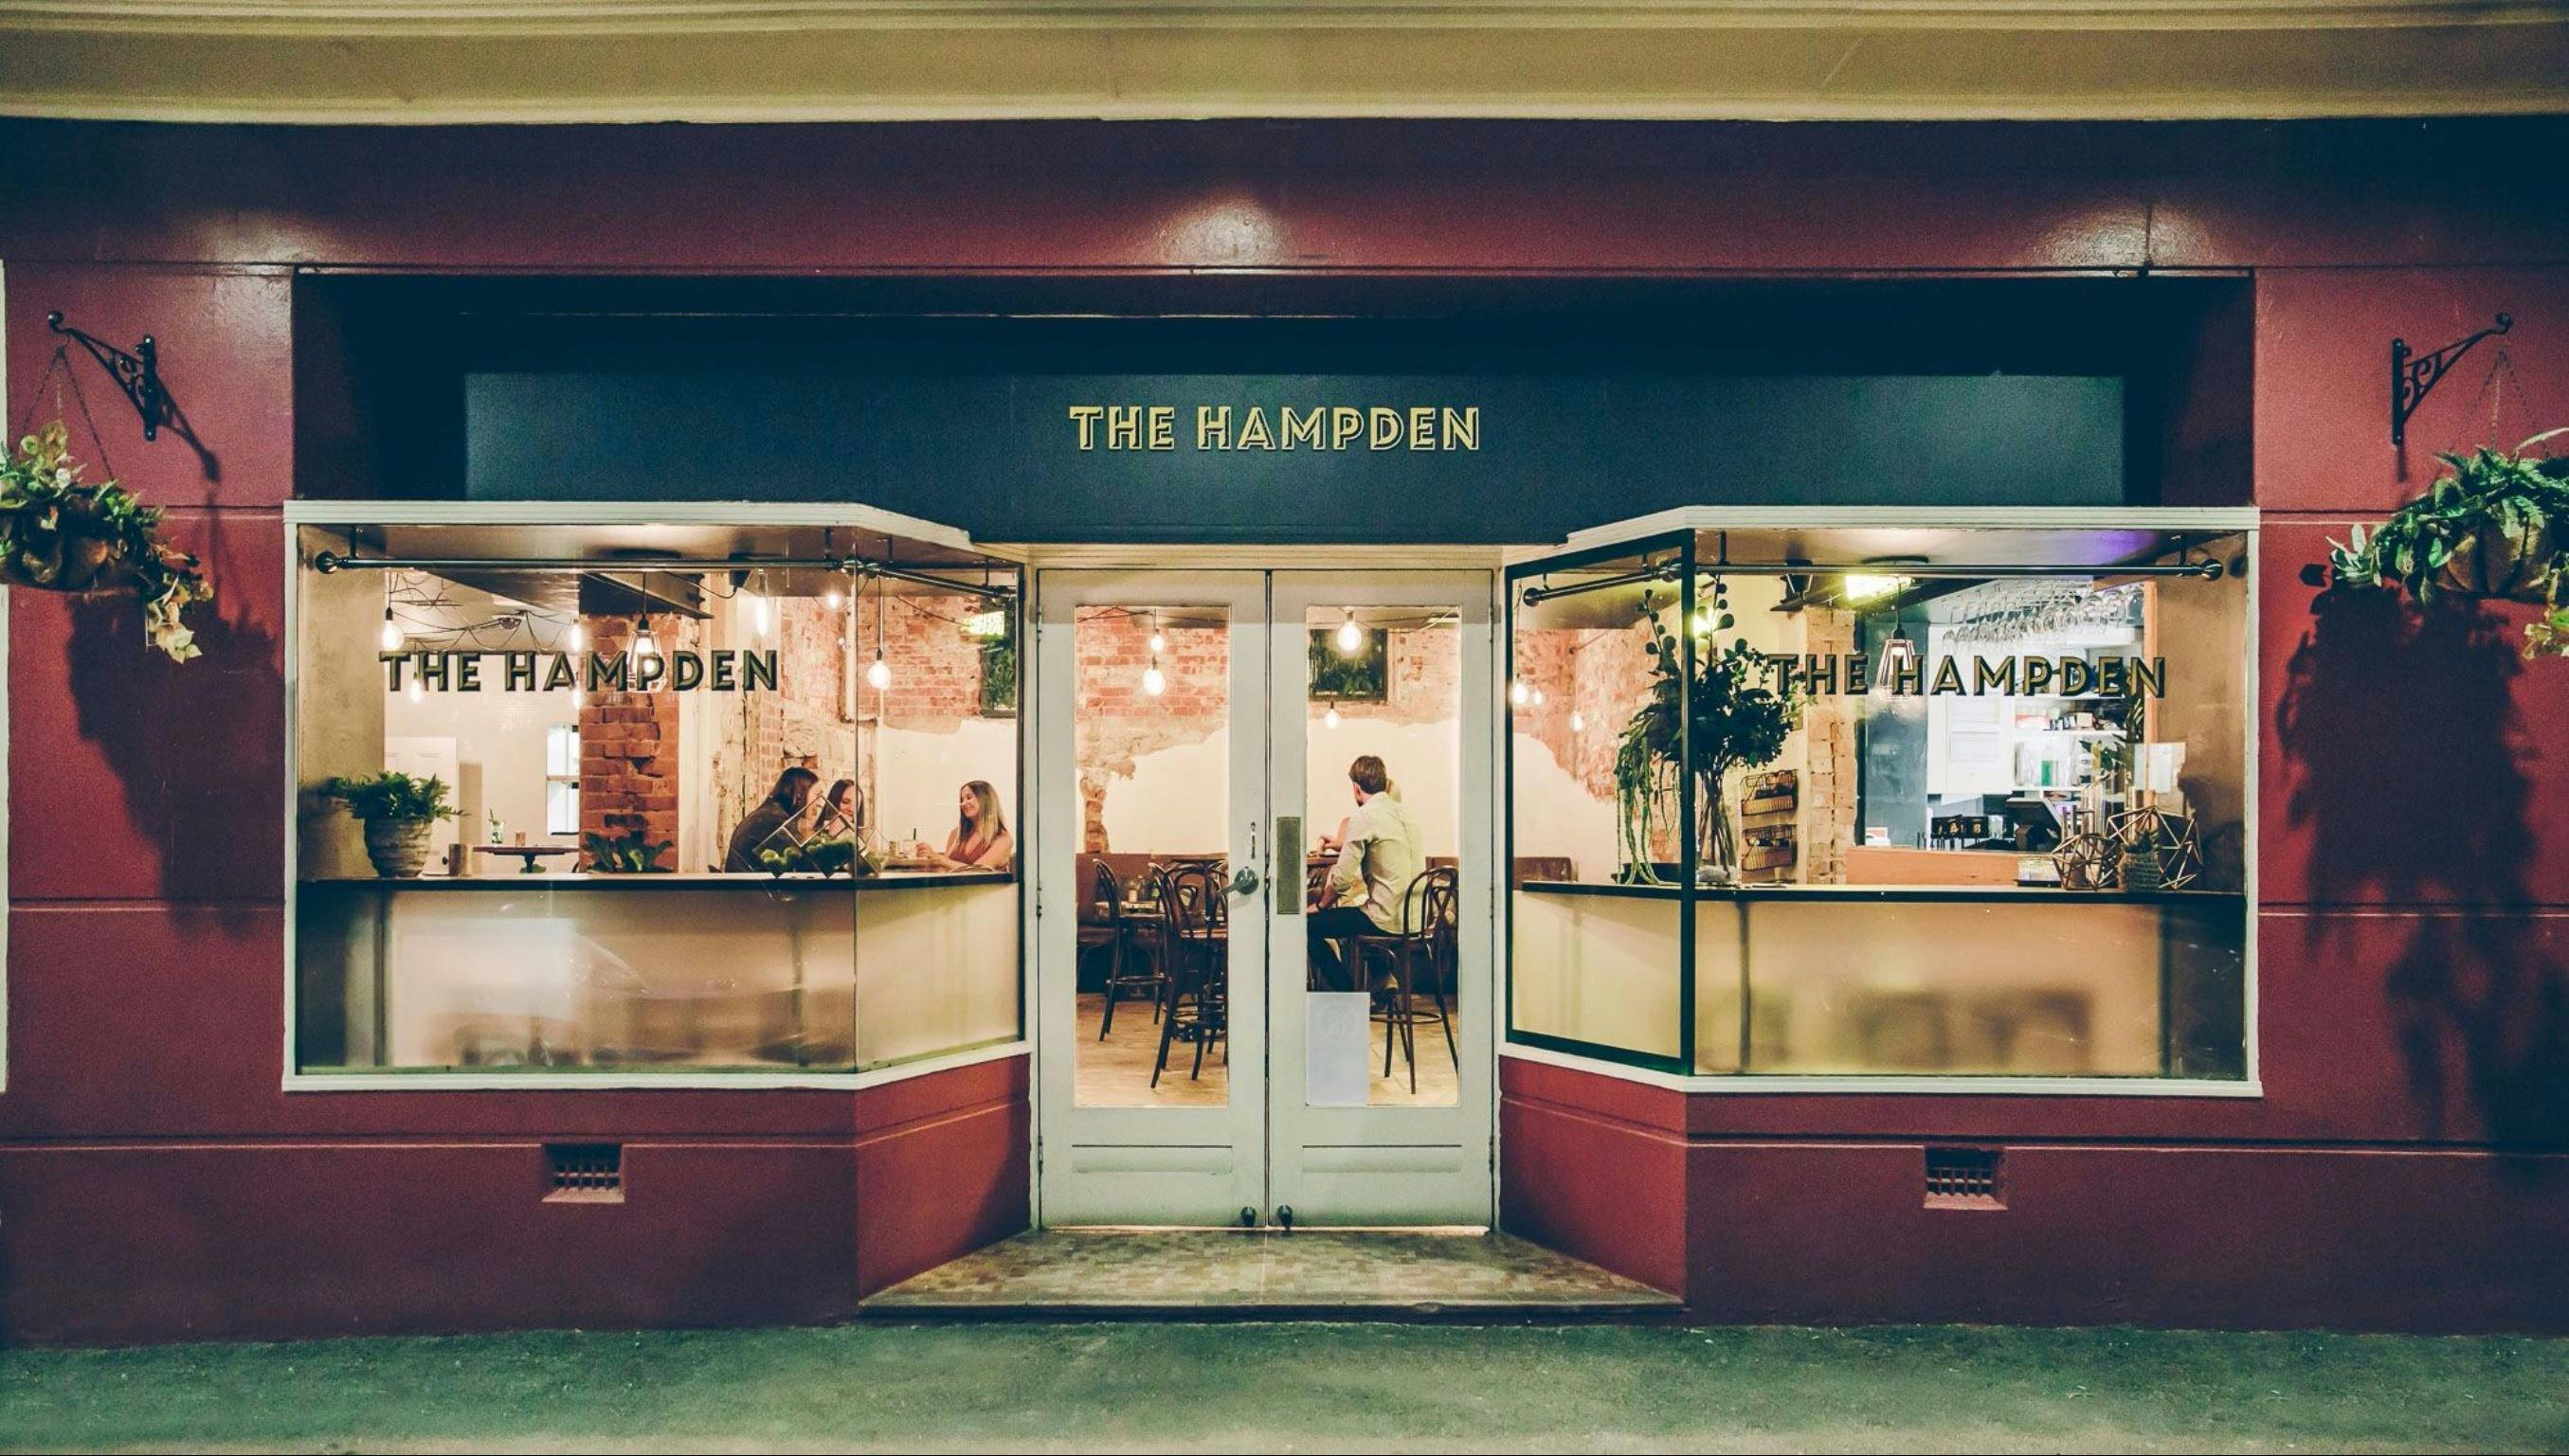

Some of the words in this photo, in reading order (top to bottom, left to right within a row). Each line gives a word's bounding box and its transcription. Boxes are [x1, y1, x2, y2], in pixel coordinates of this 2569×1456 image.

[1069, 405, 1175, 450] THE
[1197, 405, 1479, 451] HAMPDEN
[379, 650, 481, 692] THE
[503, 650, 779, 692] HAMPDEN
[1767, 653, 1870, 696] THE
[1892, 654, 2166, 699] HAMPDEN
